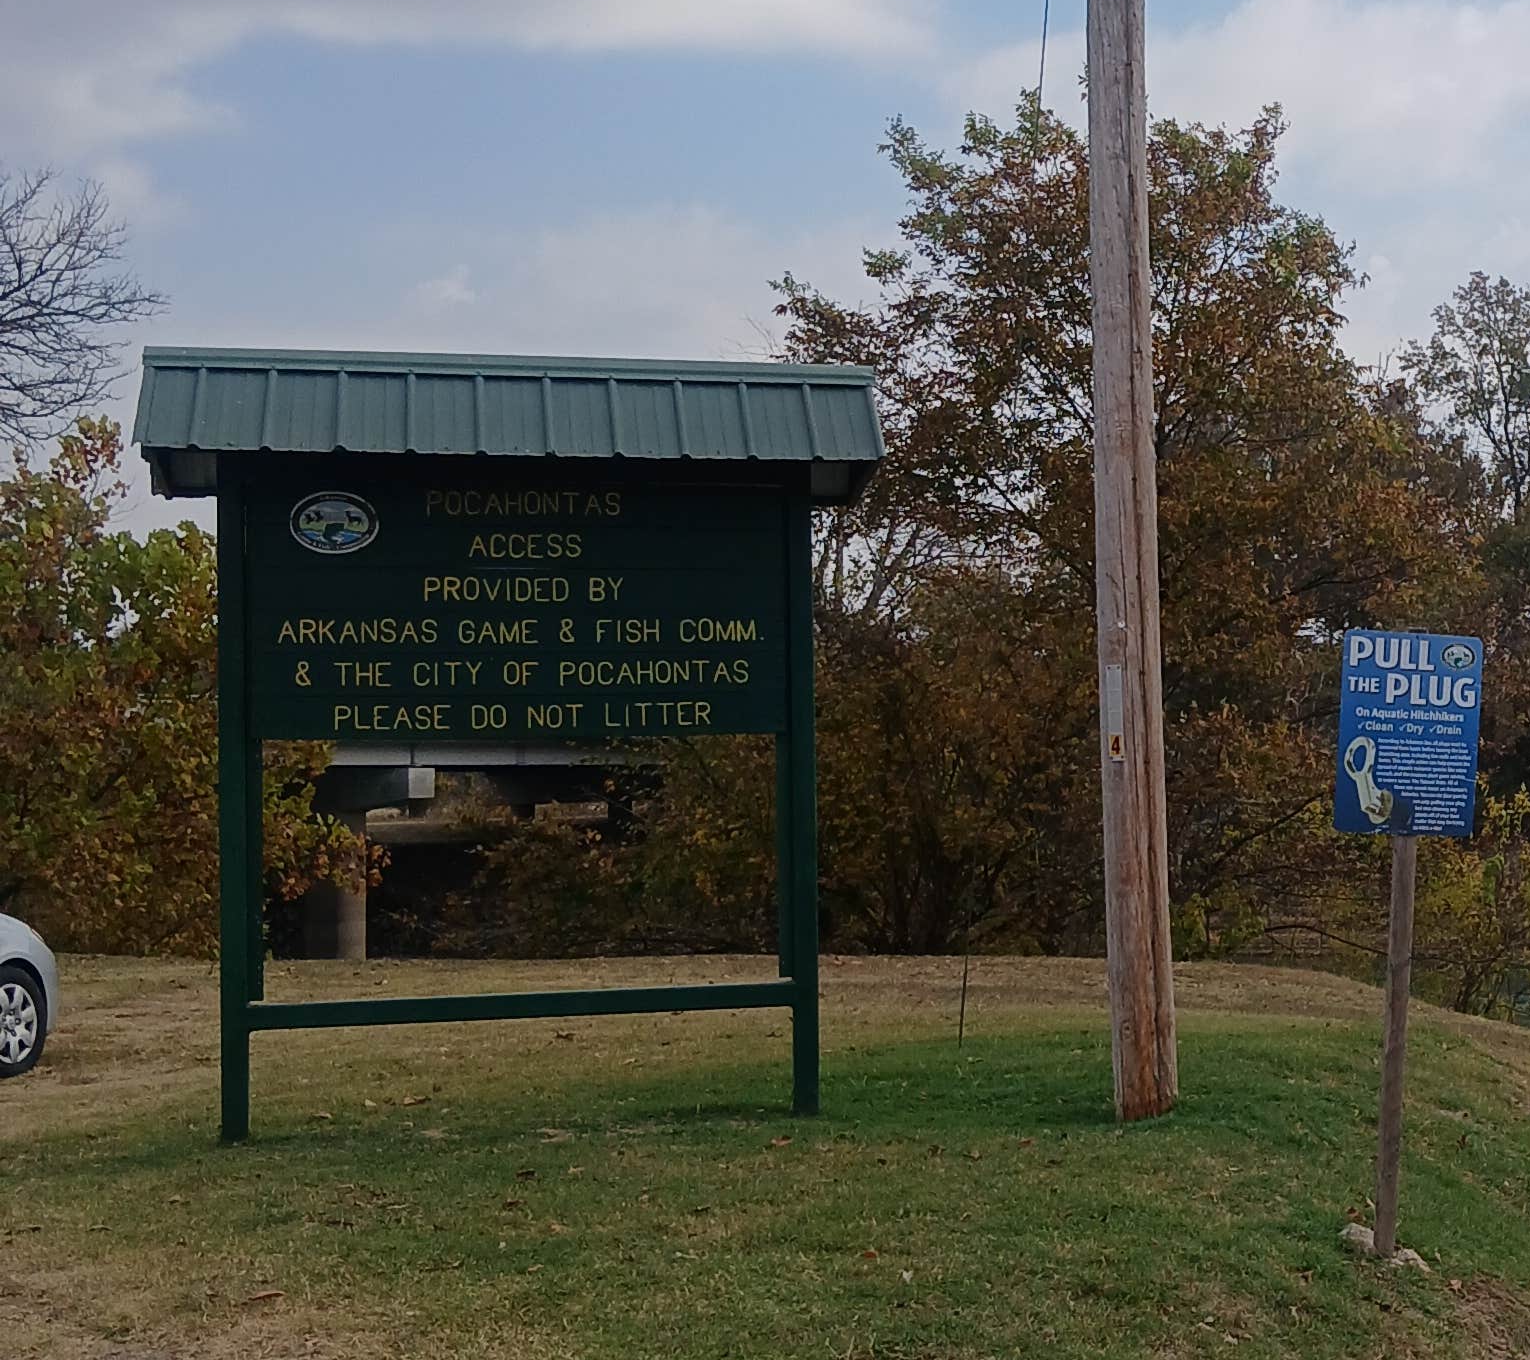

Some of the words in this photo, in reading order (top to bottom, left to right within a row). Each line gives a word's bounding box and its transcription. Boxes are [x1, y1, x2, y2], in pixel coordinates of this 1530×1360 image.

[426, 491, 622, 516] POCAHONTAS
[468, 534, 582, 558] ACCESS
[423, 577, 569, 602] PROVIDED
[589, 577, 623, 601] BY
[278, 619, 438, 644] ARKANSAS
[458, 619, 539, 644] GAME
[559, 619, 575, 643] &
[596, 619, 660, 643] FISH
[679, 618, 765, 642] COMM.
[1349, 635, 1435, 671] PULL
[295, 661, 311, 687] &
[333, 662, 392, 687] THE
[413, 661, 482, 686] CITY
[503, 661, 539, 685] OF
[560, 660, 750, 685] POCAHONTAS
[1348, 676, 1380, 693] THE
[1386, 673, 1476, 708] PLUG
[335, 704, 452, 730] PLEASE
[472, 704, 506, 729] DO
[527, 704, 584, 729] NOT
[605, 702, 711, 727] LITTER
[1355, 707, 1370, 717] On
[1371, 708, 1409, 721] Aquatic
[1407, 723, 1424, 736] Dry
[1437, 725, 1462, 735] Drain
[1112, 736, 1120, 754] 4
